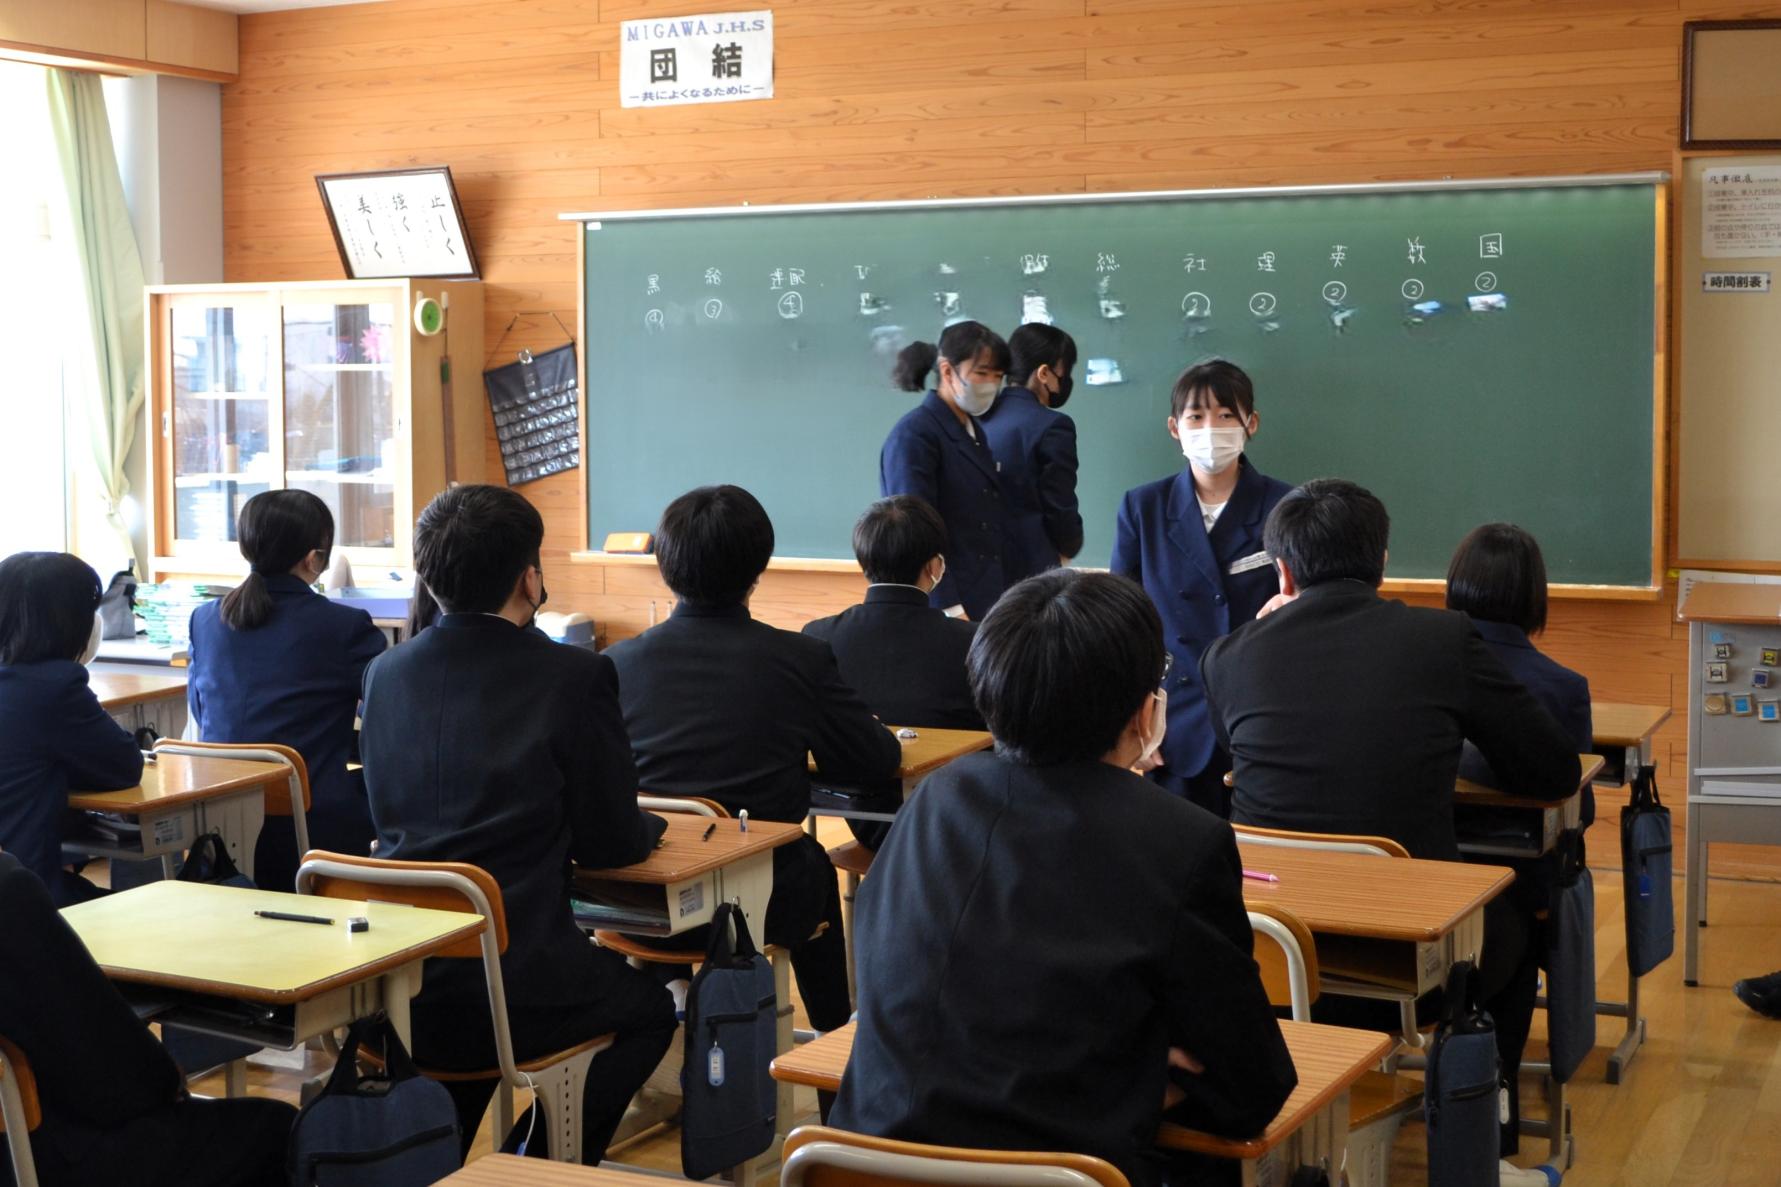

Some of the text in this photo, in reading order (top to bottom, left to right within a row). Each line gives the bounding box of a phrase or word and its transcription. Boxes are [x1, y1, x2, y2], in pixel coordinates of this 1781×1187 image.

[627, 19, 765, 42] MIGAWA J.H.S
[1480, 232, 1503, 258] 国
[1710, 275, 1762, 289] 時間割表
